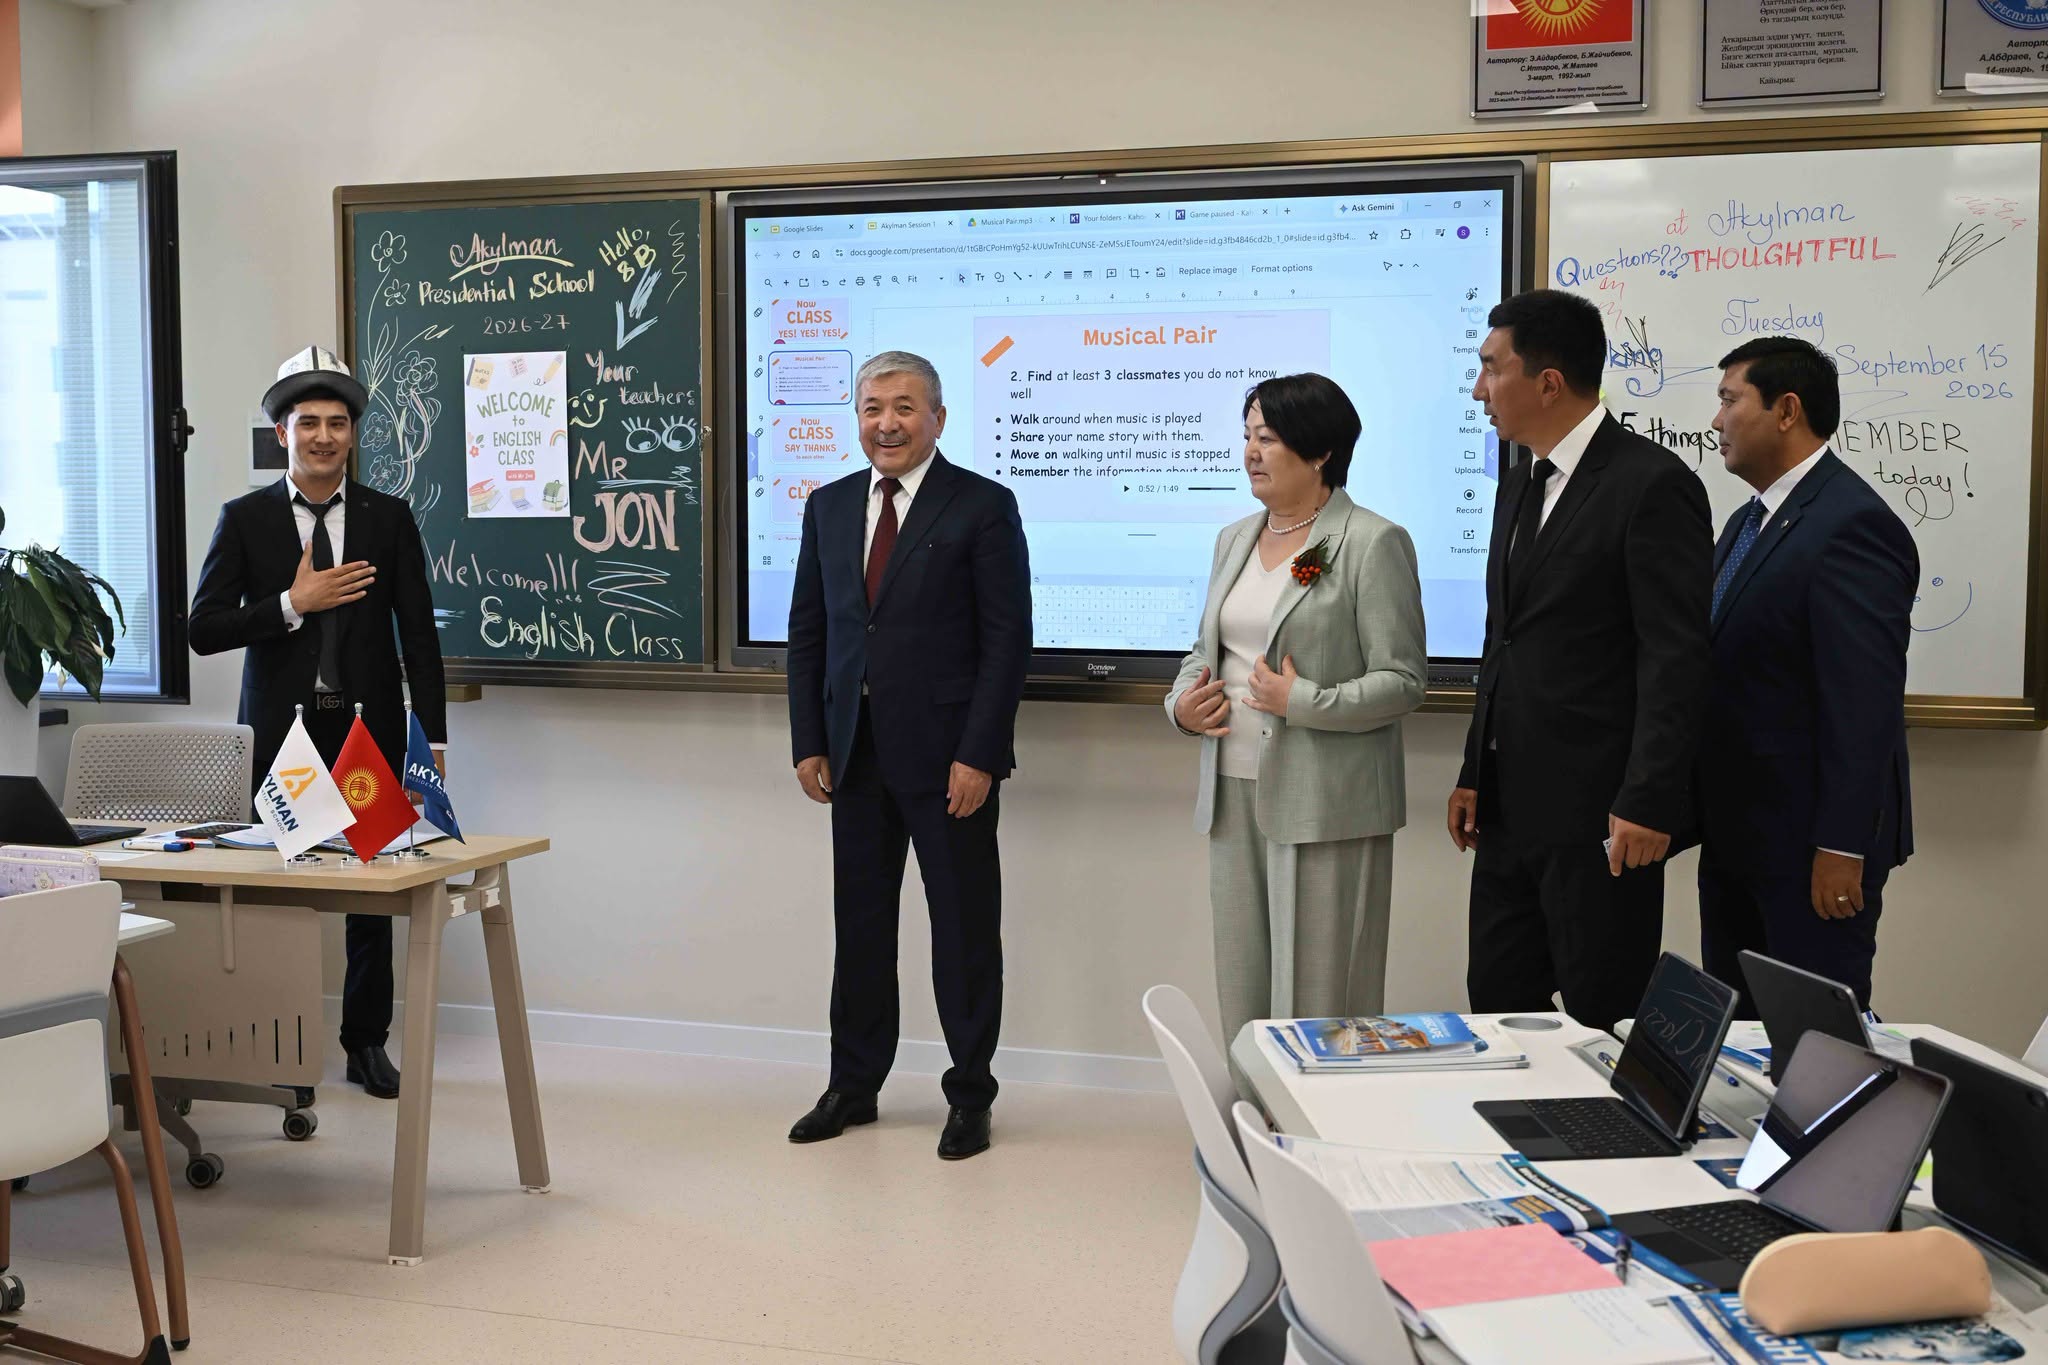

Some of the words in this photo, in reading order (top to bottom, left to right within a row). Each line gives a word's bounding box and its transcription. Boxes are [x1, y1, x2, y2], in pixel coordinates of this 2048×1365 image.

[1351, 204, 1365, 212] Ask
[1367, 203, 1395, 212] Gemini
[980, 218, 1004, 226] Musical
[1005, 217, 1033, 225] Pair.mp3
[1099, 214, 1122, 222] folders
[1666, 208, 1689, 235] at
[1708, 199, 1855, 245] Akylman
[783, 226, 805, 235] Google
[880, 222, 907, 231] Akylman
[908, 221, 929, 229] Session
[450, 232, 563, 275] Akylman
[1687, 237, 1897, 272] THOUGHTFUL
[1178, 267, 1211, 277] Replace
[1212, 266, 1238, 276] image
[1251, 265, 1280, 273] Format
[1281, 264, 1313, 274] options
[907, 275, 918, 283] Fit
[419, 275, 516, 306] Presidential
[529, 269, 595, 300] School
[483, 313, 571, 335] 2026-27
[787, 310, 833, 325] CLASS
[1721, 298, 1827, 346] Tuesday
[778, 329, 797, 338] YES!
[800, 328, 819, 338] YES!
[822, 328, 841, 337] YES!
[1083, 326, 1166, 347] Musical
[1173, 325, 1218, 345] Pair
[1453, 346, 1479, 354] Templa
[585, 350, 639, 385] Your
[1836, 344, 1967, 387] September
[1976, 343, 2008, 371] 15
[1010, 370, 1023, 382] 2.
[1027, 370, 1052, 382] Find
[1056, 371, 1069, 381] at
[1072, 369, 1100, 382] least
[1103, 370, 1111, 380] 3
[1116, 368, 1181, 381] classmates
[1183, 371, 1204, 385] you
[1207, 367, 1222, 379] do
[1225, 368, 1244, 379] not
[1248, 366, 1277, 378] know
[1010, 387, 1032, 399] well
[1945, 380, 2013, 399] 2026
[476, 391, 556, 418] WELCOME
[512, 415, 526, 427] to
[1010, 413, 1039, 425] Walk
[1042, 413, 1081, 425] around
[1084, 413, 1113, 424] when
[1116, 412, 1148, 424] music
[1151, 412, 1161, 424] is
[1164, 411, 1202, 427] played
[493, 431, 542, 448] ENGLISH
[788, 427, 834, 440] CLASS
[1010, 431, 1045, 443] Share
[1047, 433, 1073, 445] your
[1076, 433, 1105, 442] name
[1108, 431, 1140, 444] story
[1142, 430, 1167, 442] with
[1171, 430, 1204, 442] them.
[784, 444, 801, 453] SAY
[803, 444, 837, 453] THANKS
[1643, 417, 1719, 472] things
[1834, 420, 1969, 454] EMBER
[498, 450, 535, 466] CLASS
[1010, 449, 1040, 460] Move
[1044, 451, 1058, 460] on
[1062, 448, 1103, 463] walking
[1106, 447, 1132, 460] until
[1135, 448, 1168, 460] music
[1171, 447, 1181, 459] is
[1184, 447, 1231, 462] stopped
[1010, 466, 1070, 477] Remember
[1073, 465, 1092, 477] the
[1454, 467, 1486, 475] Uploads
[788, 486, 818, 499] CLA
[1138, 485, 1155, 493] 0:52
[1163, 485, 1179, 493] 1:49
[572, 489, 680, 553] JON
[1450, 546, 1488, 554] Transform
[480, 596, 595, 660] English
[605, 612, 684, 660] Class
[408, 762, 446, 793] AKYL
[264, 773, 299, 832] YLMAN
